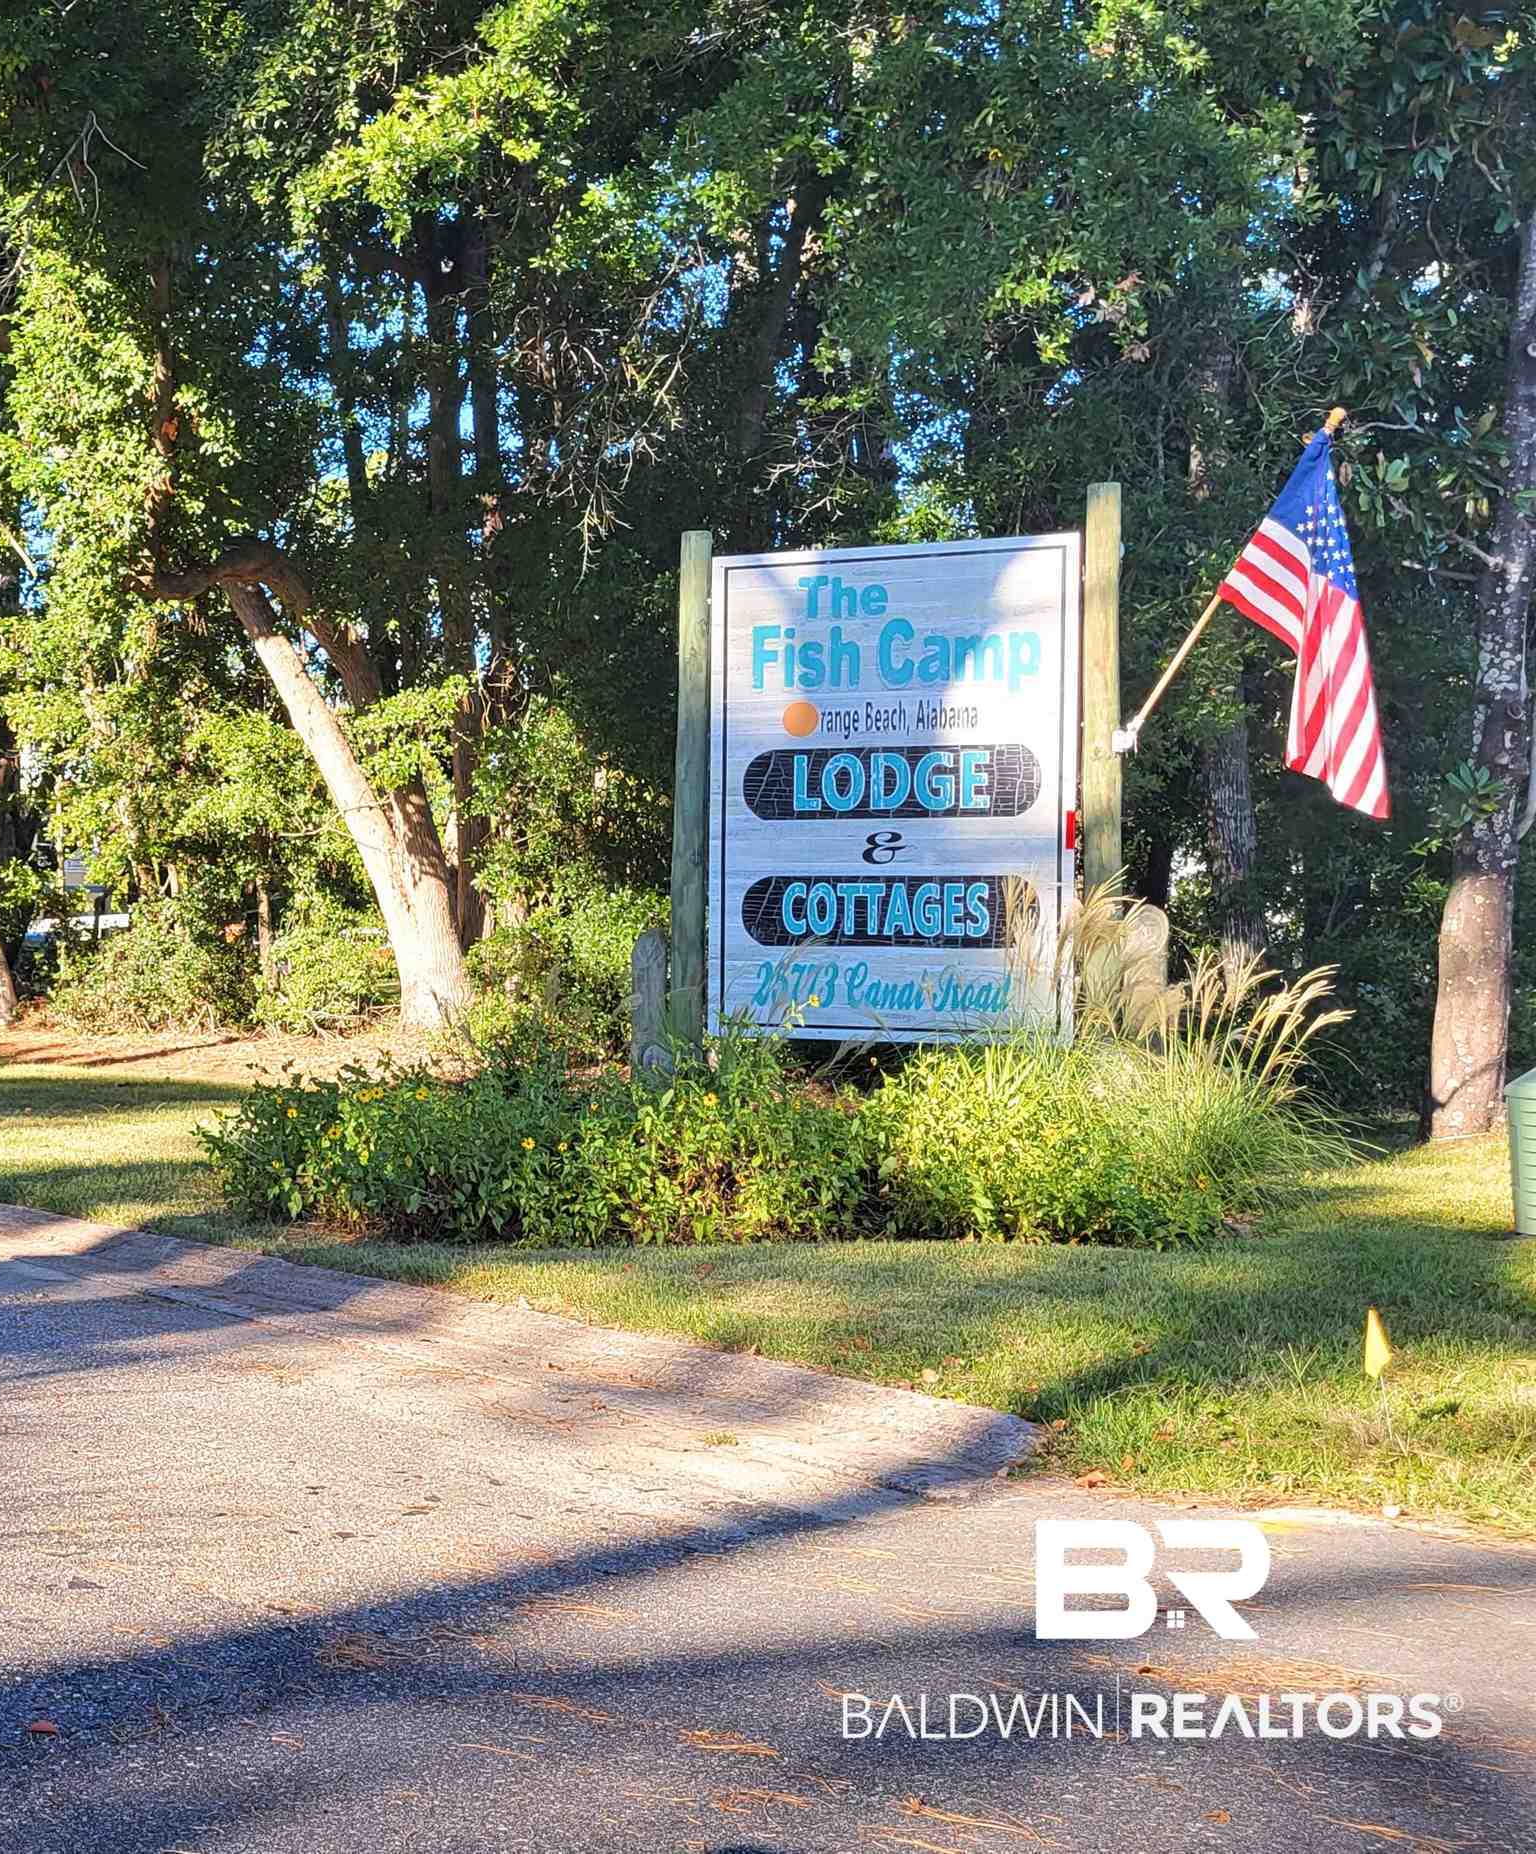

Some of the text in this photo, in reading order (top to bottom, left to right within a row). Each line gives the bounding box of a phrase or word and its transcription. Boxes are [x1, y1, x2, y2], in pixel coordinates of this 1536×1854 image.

[798, 575, 889, 619] The
[752, 618, 1041, 690] Fish Camp
[864, 701, 910, 736] Beach,
[915, 698, 979, 730] Alabama
[792, 751, 991, 812] LODGE
[862, 831, 907, 865] &
[782, 882, 989, 937] COTTAGES
